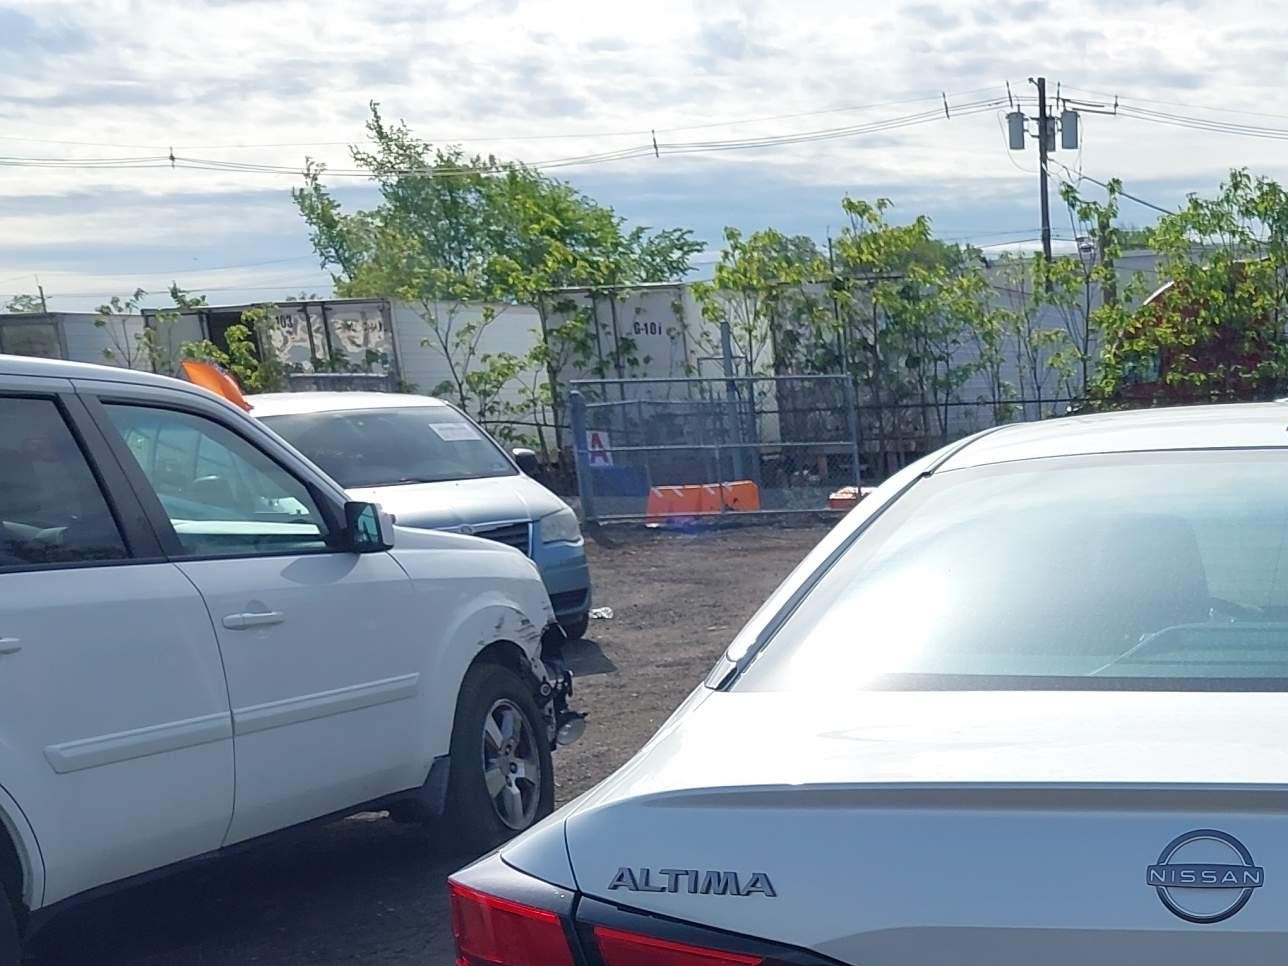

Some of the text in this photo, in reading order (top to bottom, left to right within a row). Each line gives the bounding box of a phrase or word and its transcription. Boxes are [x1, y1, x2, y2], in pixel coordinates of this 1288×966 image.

[591, 432, 609, 464] A
[608, 867, 777, 897] ALTIMA
[1149, 868, 1261, 884] NISSAN
